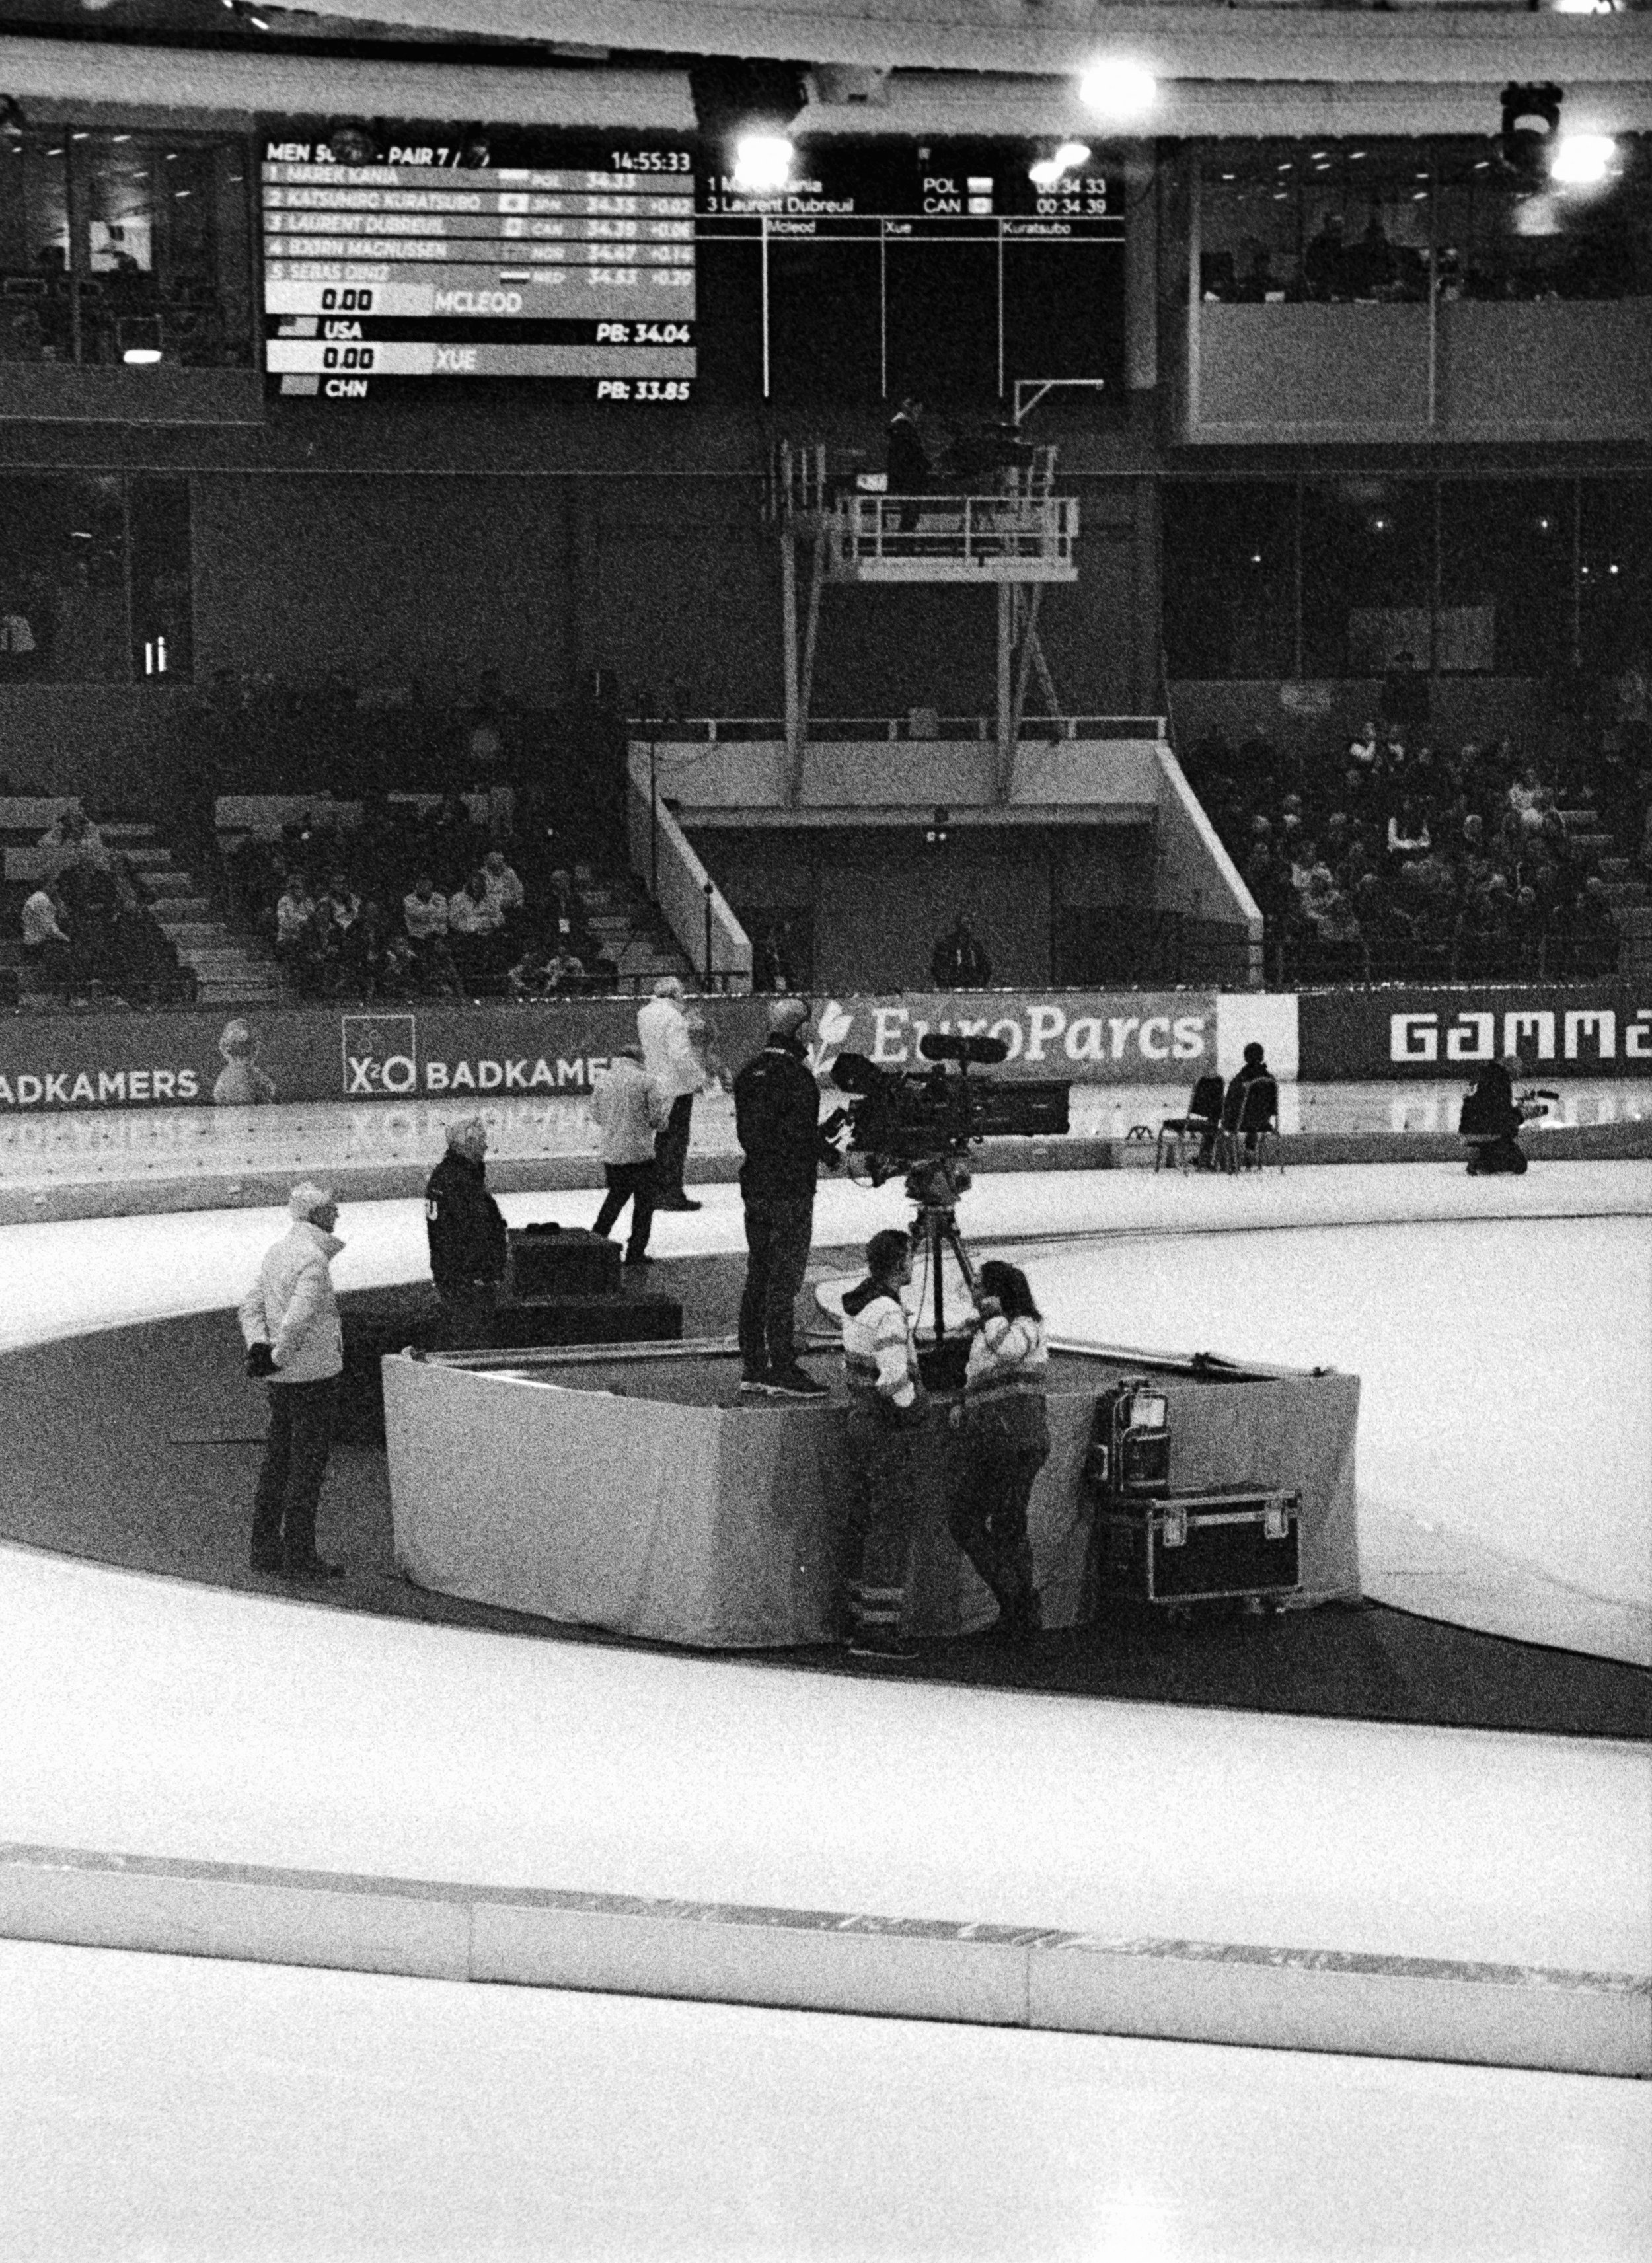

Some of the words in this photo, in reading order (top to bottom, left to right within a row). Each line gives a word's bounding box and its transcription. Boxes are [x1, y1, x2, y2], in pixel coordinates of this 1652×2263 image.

[267, 142, 311, 161] MEN
[388, 146, 433, 165] PAIR
[437, 147, 449, 165] 7
[611, 151, 691, 171] 14:55:33
[270, 166, 278, 181] 1
[286, 165, 345, 183] MAREK
[348, 167, 398, 184] KANIA
[587, 172, 636, 189] 34.33
[708, 176, 716, 192] 1
[924, 177, 959, 194] POL
[267, 190, 282, 207] 2
[383, 192, 481, 211] KURATSUBO
[707, 196, 718, 212] 3
[721, 196, 782, 213] Laurent
[786, 197, 854, 213] Dubreuil
[924, 198, 961, 213] CAN
[268, 214, 282, 231] 3
[288, 214, 361, 233] LAURENT
[365, 216, 446, 235] DUBREUIL
[531, 222, 563, 237] CAN
[587, 220, 637, 237] 34.39
[886, 221, 912, 234] Xue
[1003, 221, 1072, 234] Kuratsubo
[268, 239, 282, 256] 4
[347, 241, 448, 258] MAGNUSSEN
[269, 262, 283, 279] 5
[652, 270, 693, 286] +0.20
[322, 288, 373, 311] 0.00
[435, 291, 523, 313] MCLEOD
[324, 320, 363, 340] USA
[597, 323, 630, 342] PB:
[634, 323, 690, 344] 34.04
[323, 347, 374, 369] 0.00
[436, 349, 477, 371] XUE
[325, 379, 368, 398] CHN
[597, 381, 630, 400] PB:
[634, 381, 690, 400] 33.85
[426, 1057, 609, 1090] BADKAME
